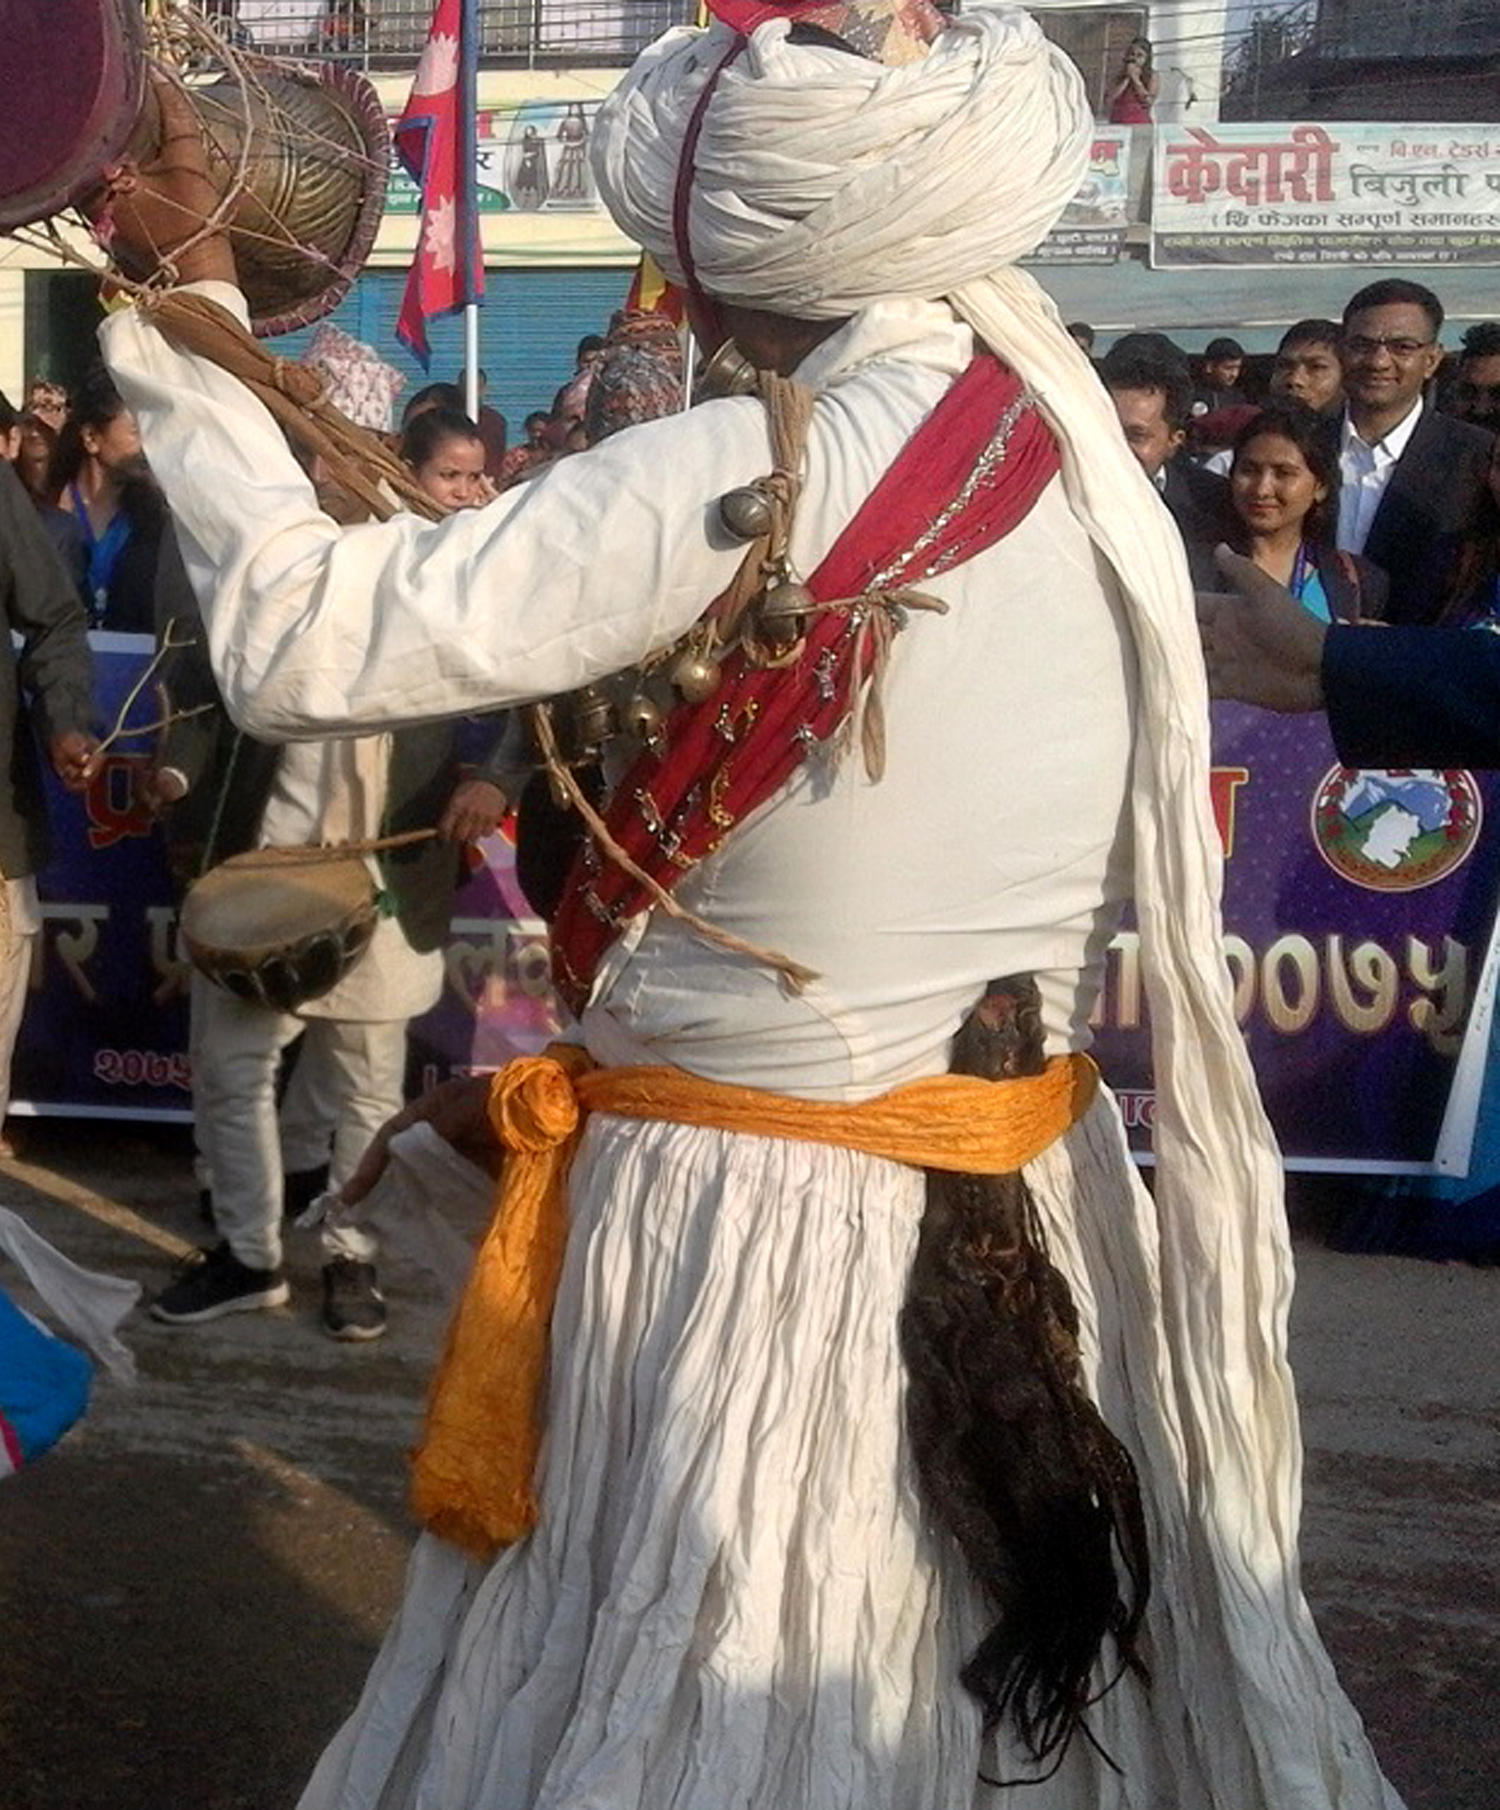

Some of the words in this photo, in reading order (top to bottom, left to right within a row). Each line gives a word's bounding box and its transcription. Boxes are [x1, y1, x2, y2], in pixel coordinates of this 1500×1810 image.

[1166, 126, 1340, 206] केदारी
[1349, 164, 1469, 206] बिजुली
[1336, 211, 1402, 231] सम्पूर्ण
